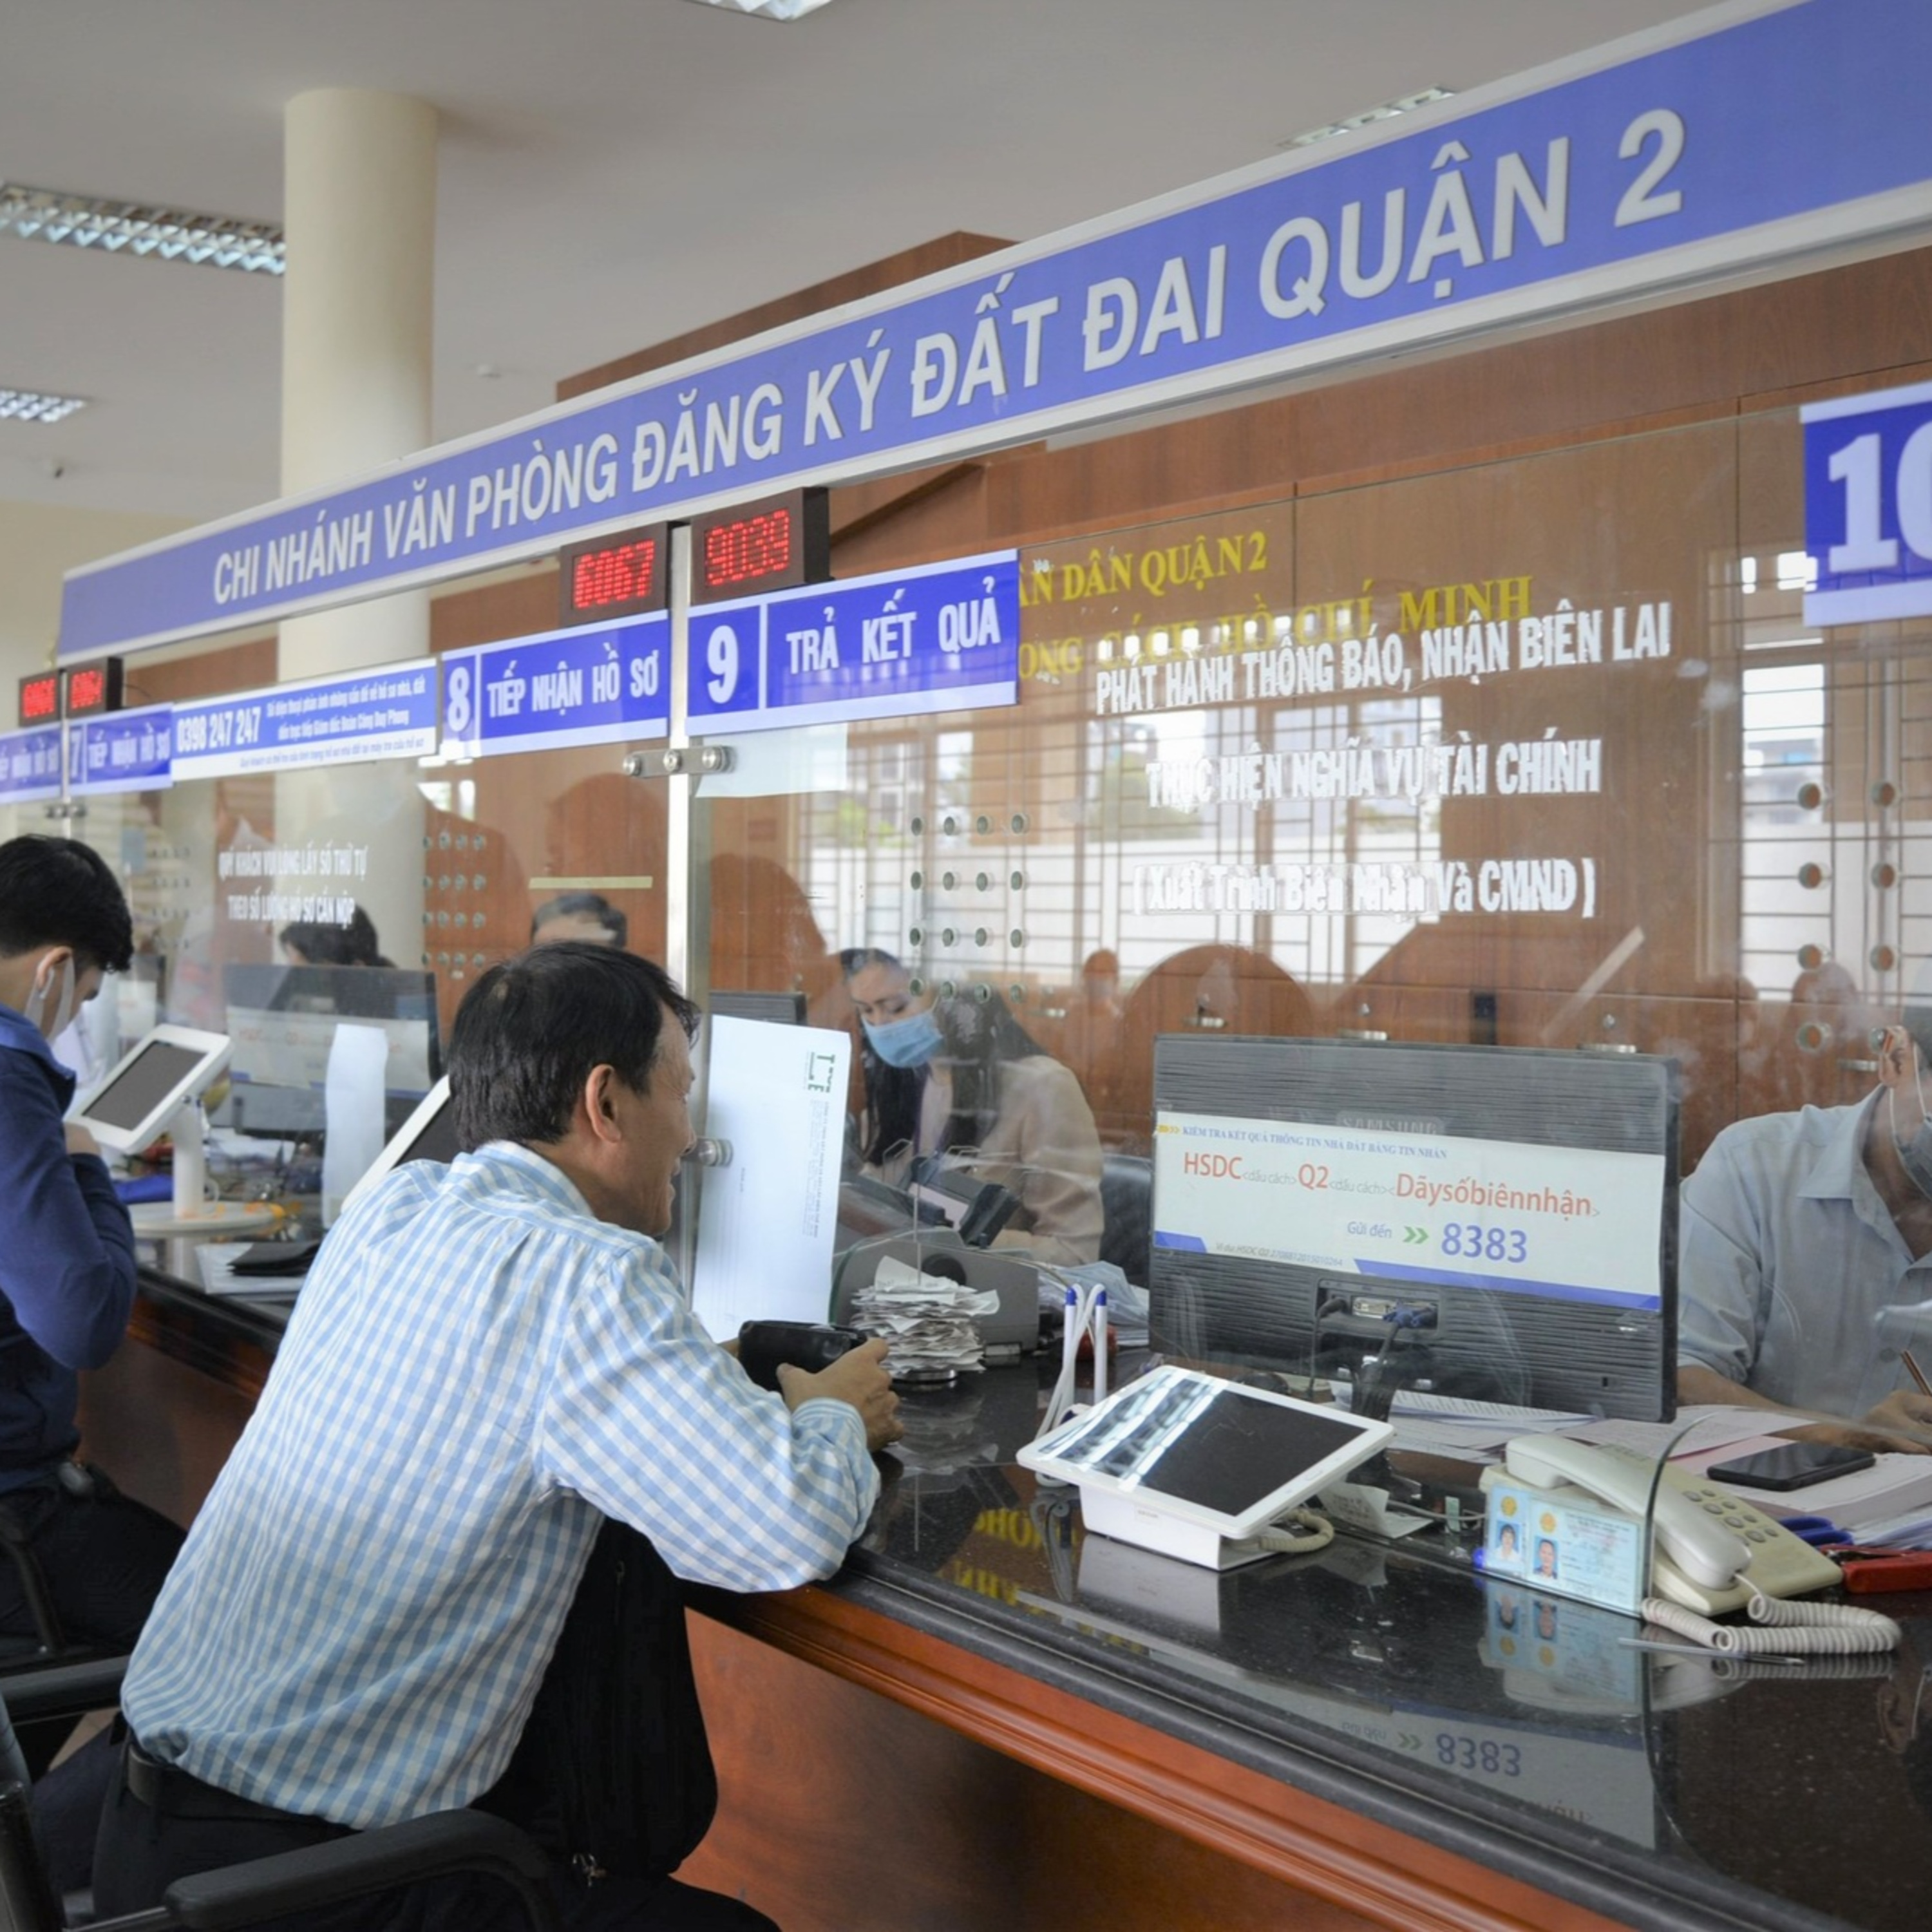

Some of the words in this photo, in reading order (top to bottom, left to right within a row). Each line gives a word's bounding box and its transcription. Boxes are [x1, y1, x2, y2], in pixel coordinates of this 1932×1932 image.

[213, 543, 260, 605] CHI
[265, 507, 372, 589] NHÁNH
[384, 479, 456, 558] VĂN
[466, 433, 618, 538] PHÒNG
[631, 382, 783, 493] ĐĂNG
[804, 328, 891, 446] KÝ
[910, 272, 1059, 419] ĐẤT
[1082, 244, 1227, 372] ĐAI
[1259, 136, 1569, 319] QUẬN
[1615, 108, 1685, 227] 2
[575, 540, 654, 607] 6067
[707, 509, 790, 585] 9039
[1063, 548, 1133, 601] DÂN
[1140, 535, 1244, 596] QUẬN
[1247, 531, 1268, 572] 2
[706, 625, 739, 704] 9
[786, 606, 840, 674] TRẢ
[861, 588, 916, 664] KẾT
[938, 576, 1001, 653] QUẢ
[1397, 576, 1533, 634] MINH
[446, 667, 470, 732] 8
[487, 660, 526, 717] TIẾP
[532, 661, 583, 716] NHẬN
[592, 643, 620, 703] HỒ
[630, 650, 659, 698] SƠ
[1097, 654, 1157, 715] PHÁT
[1166, 650, 1233, 707] HÀNH
[1242, 635, 1334, 699] THÔNG
[1342, 623, 1411, 692] BÁO,
[1421, 609, 1510, 685] NHẬN
[1519, 598, 1603, 669] BIÊN
[1613, 601, 1671, 661] LAI
[209, 710, 233, 748] 247
[236, 706, 261, 744] 247
[1221, 741, 1283, 810] HIỆN
[1292, 736, 1374, 799] NGHĨA
[1384, 746, 1425, 806] VỤ
[1435, 730, 1488, 795] TÀI
[1496, 727, 1602, 794] CHÍNH
[1184, 1152, 1242, 1180] HSDC
[1442, 1222, 1528, 1264] 8383
